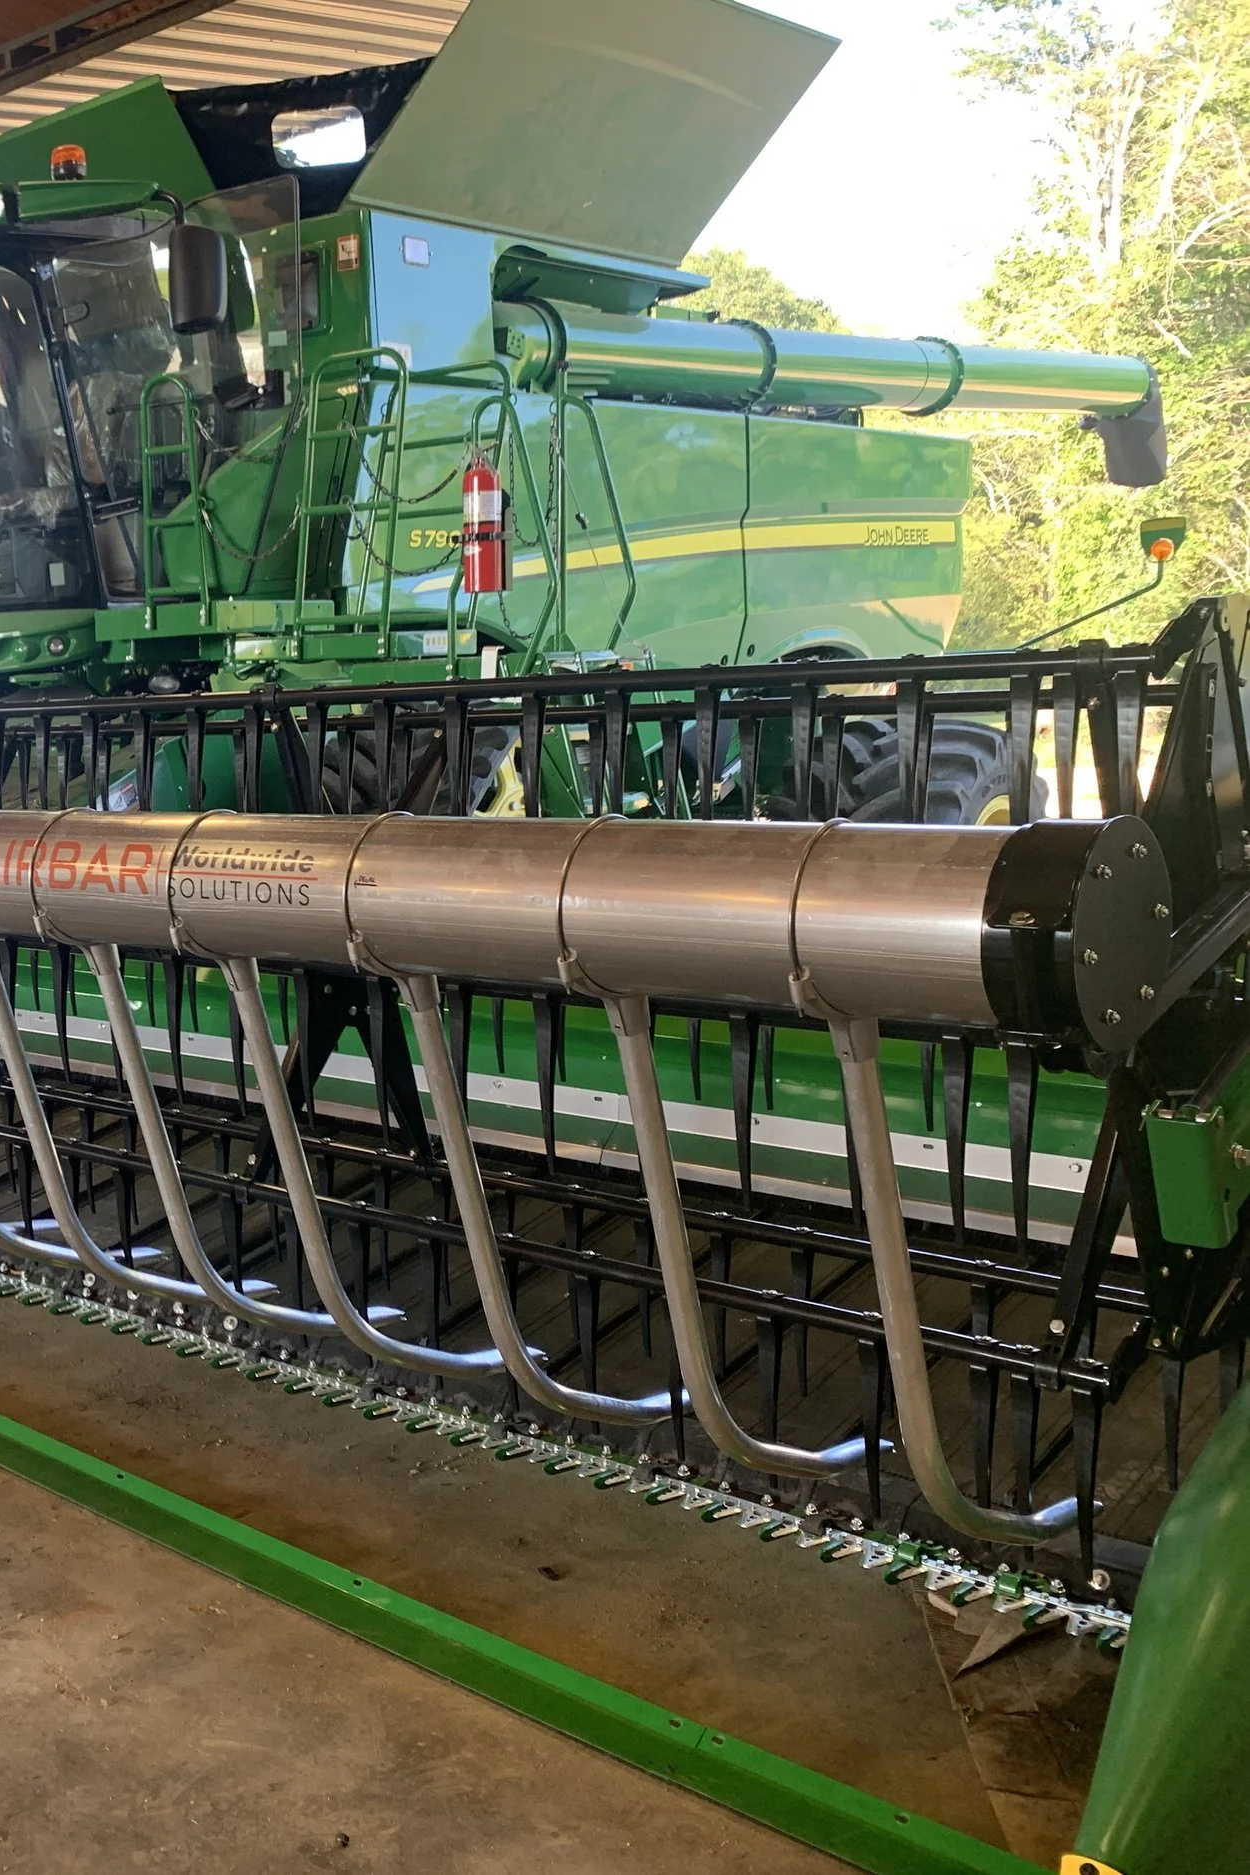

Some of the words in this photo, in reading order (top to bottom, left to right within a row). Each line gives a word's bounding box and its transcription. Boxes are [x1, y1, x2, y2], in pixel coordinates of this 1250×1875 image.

[864, 525, 893, 545] JOHN
[895, 525, 930, 545] DEERE
[174, 845, 315, 873] Worldwide
